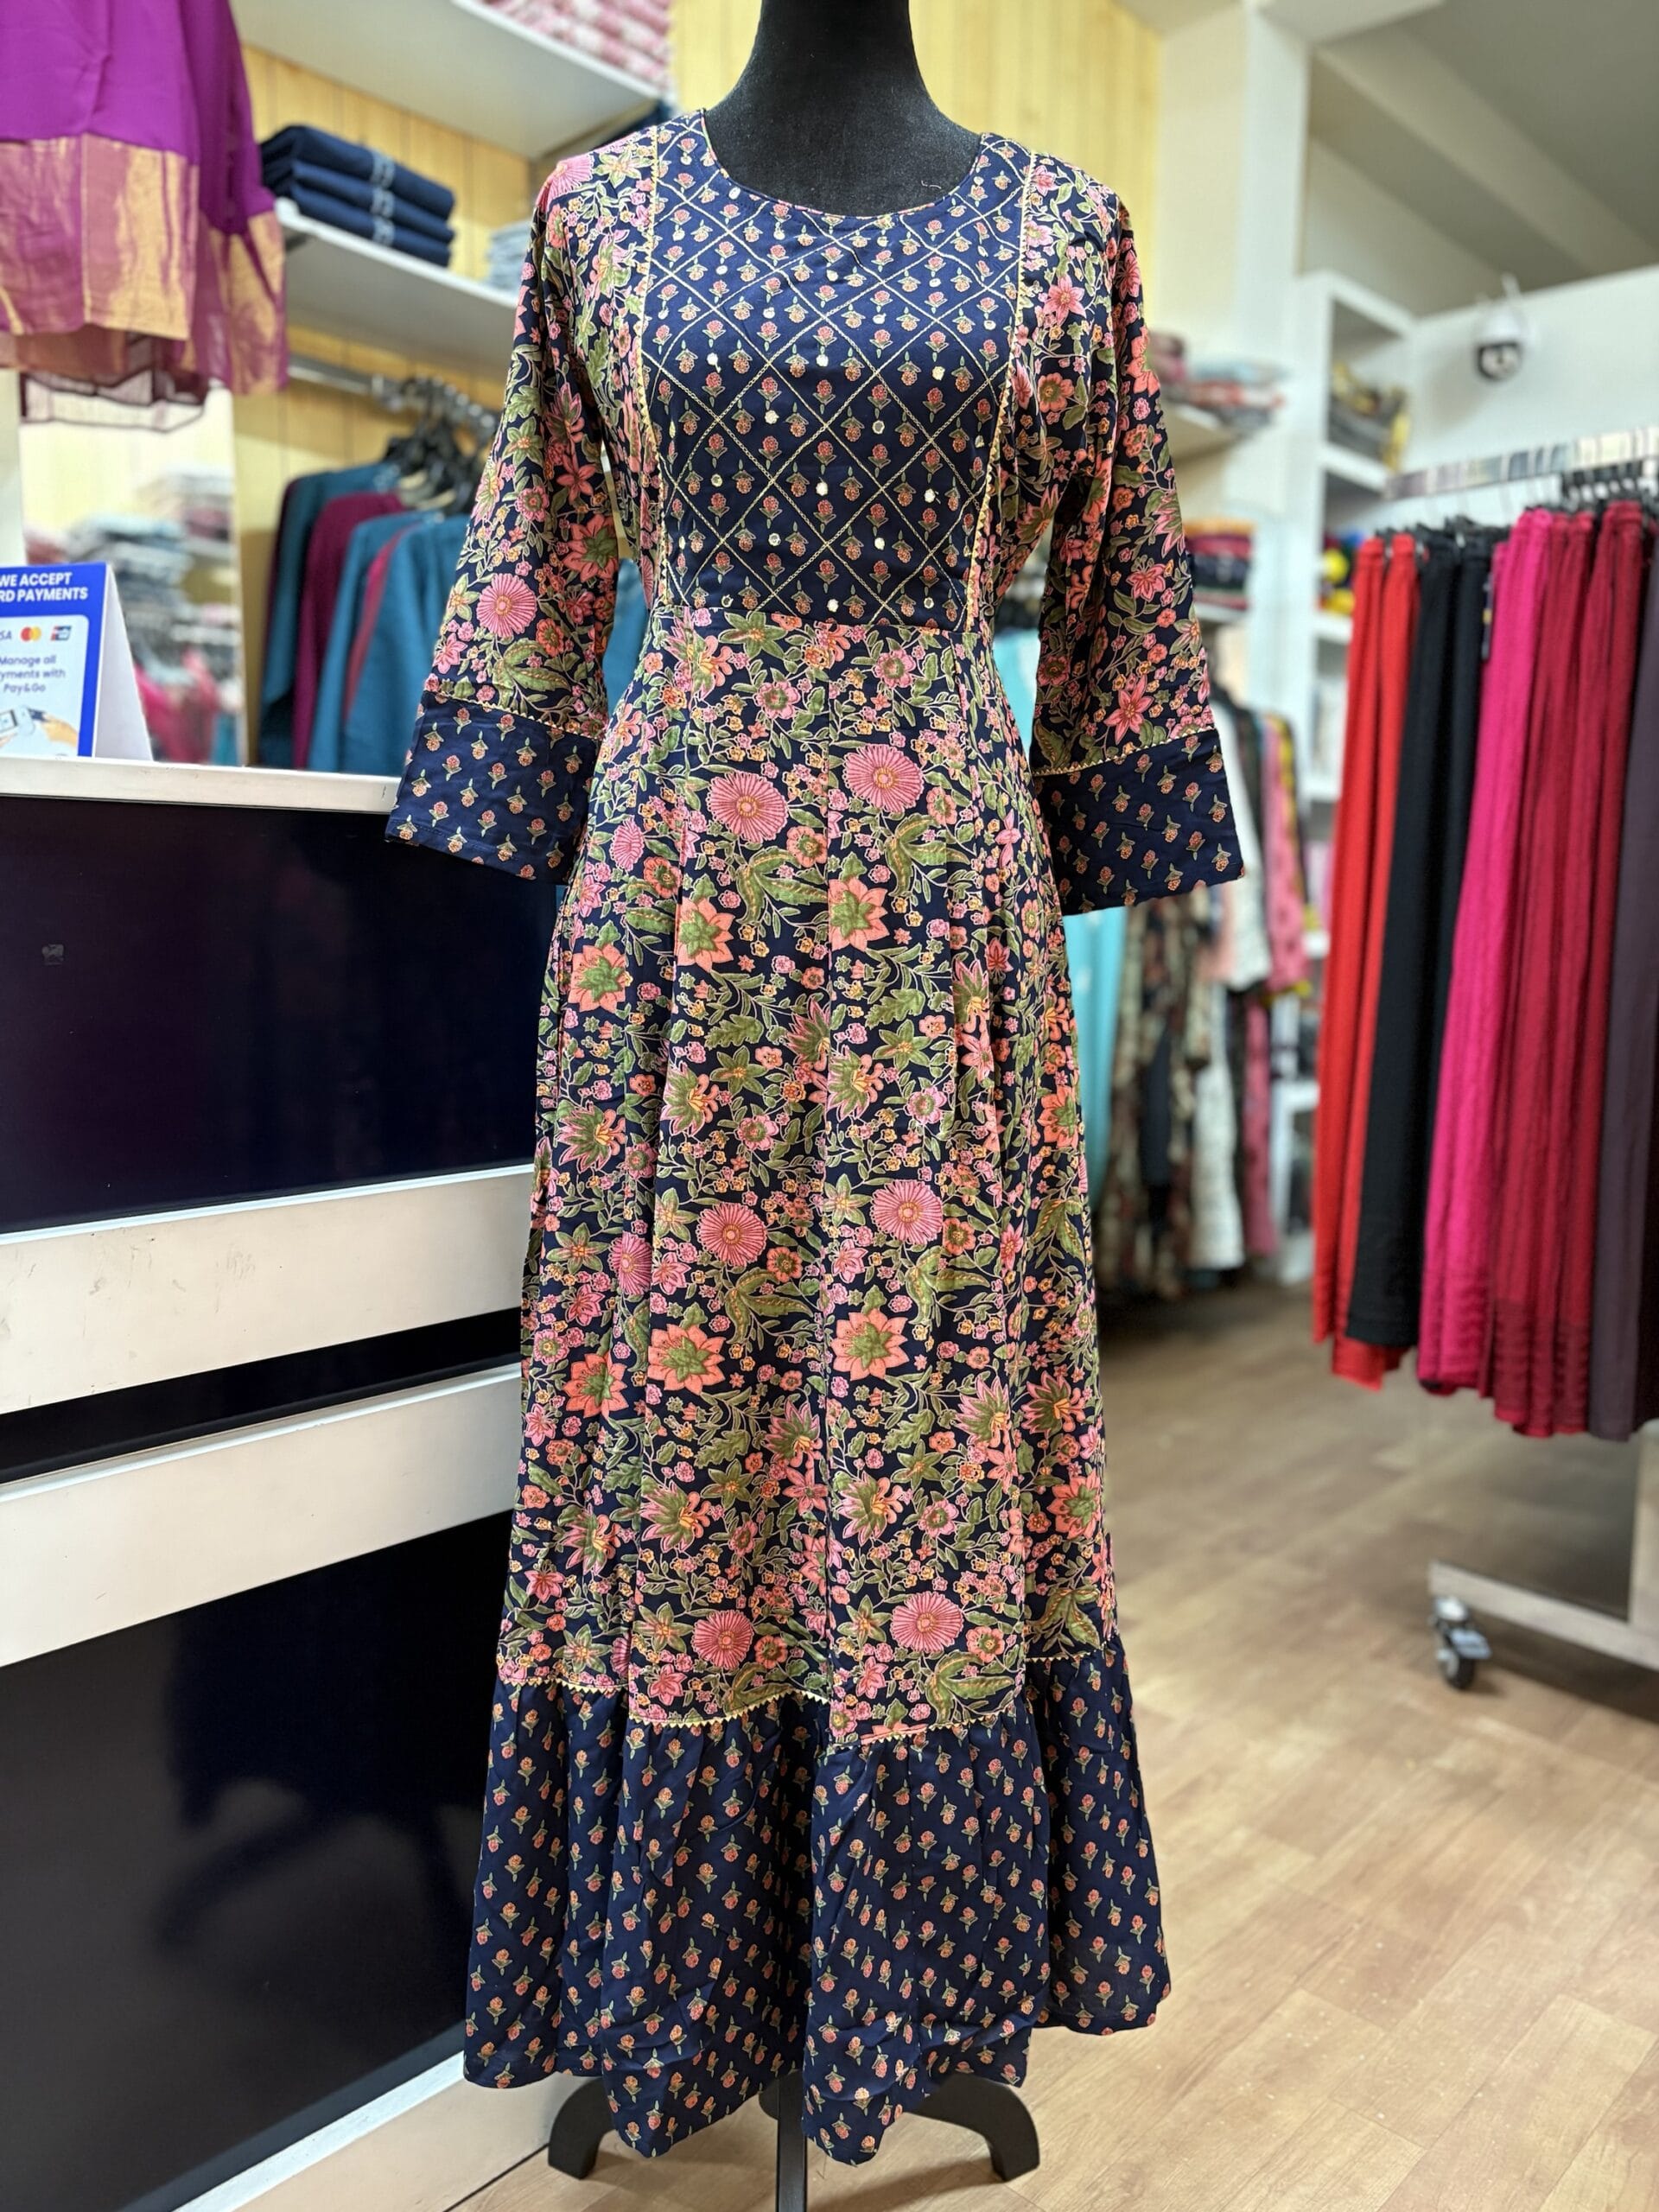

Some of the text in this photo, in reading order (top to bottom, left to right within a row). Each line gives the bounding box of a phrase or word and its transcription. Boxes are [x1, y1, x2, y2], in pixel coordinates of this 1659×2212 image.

[0, 572, 73, 587] WE ACCEPT
[16, 587, 87, 601] PAYMENTS
[43, 654, 57, 664] all
[42, 668, 66, 678] with
